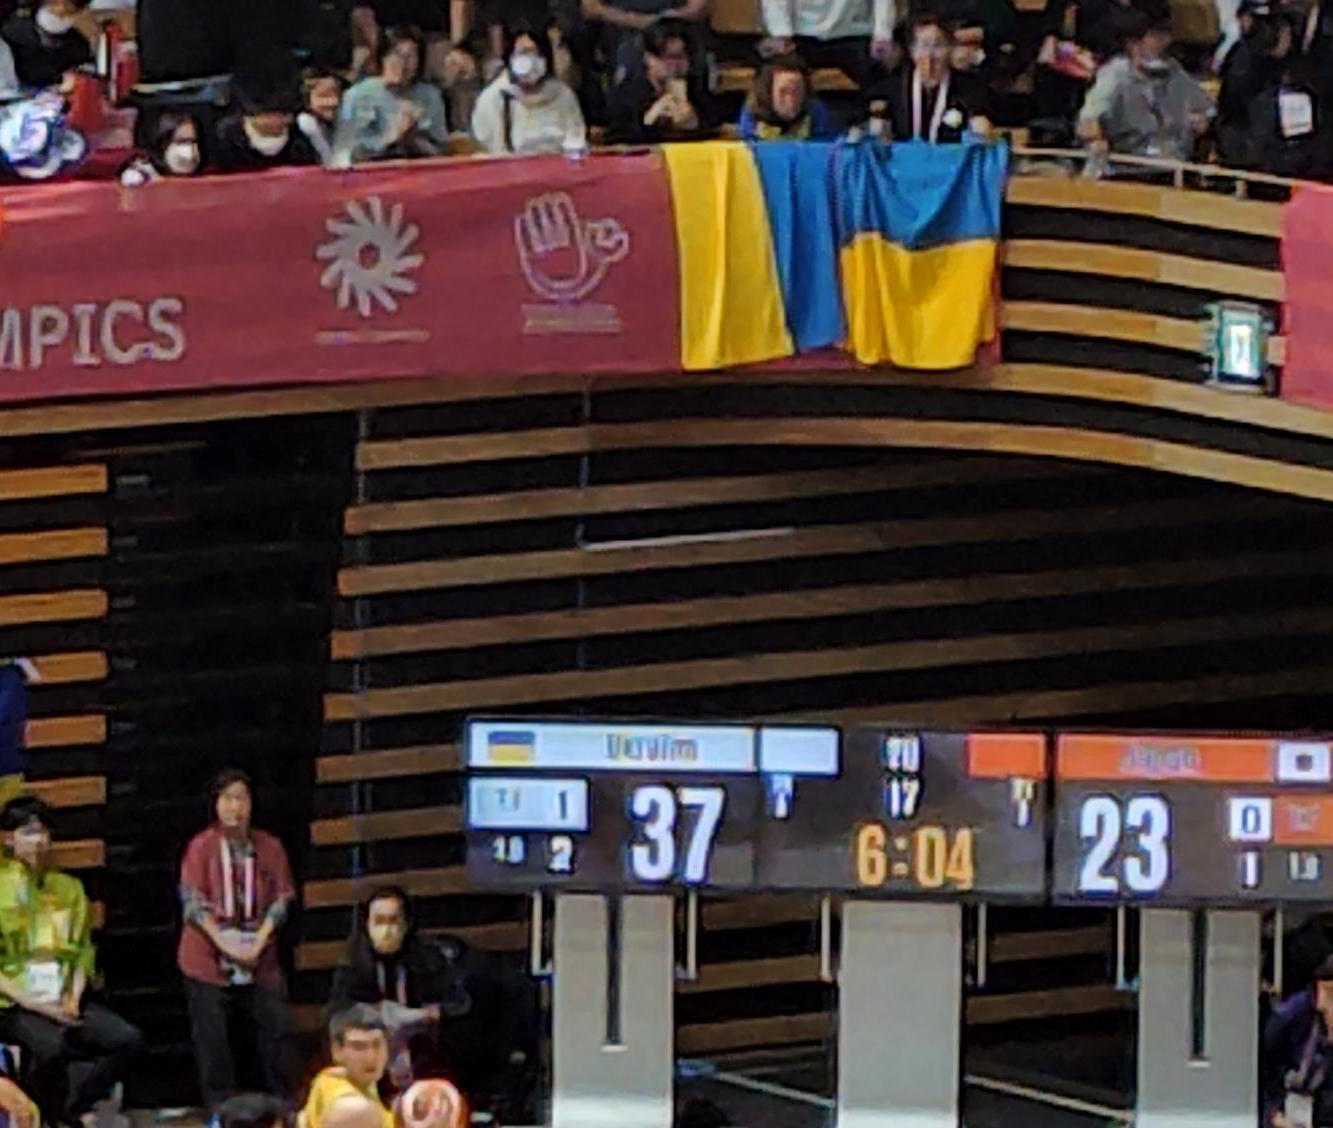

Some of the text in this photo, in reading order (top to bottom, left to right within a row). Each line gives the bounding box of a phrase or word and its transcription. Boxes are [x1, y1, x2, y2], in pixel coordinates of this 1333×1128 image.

[889, 777, 921, 818] 17
[550, 835, 572, 871] 2
[632, 785, 724, 882] 37
[857, 824, 974, 889] 6:04
[1079, 796, 1170, 891] 23
